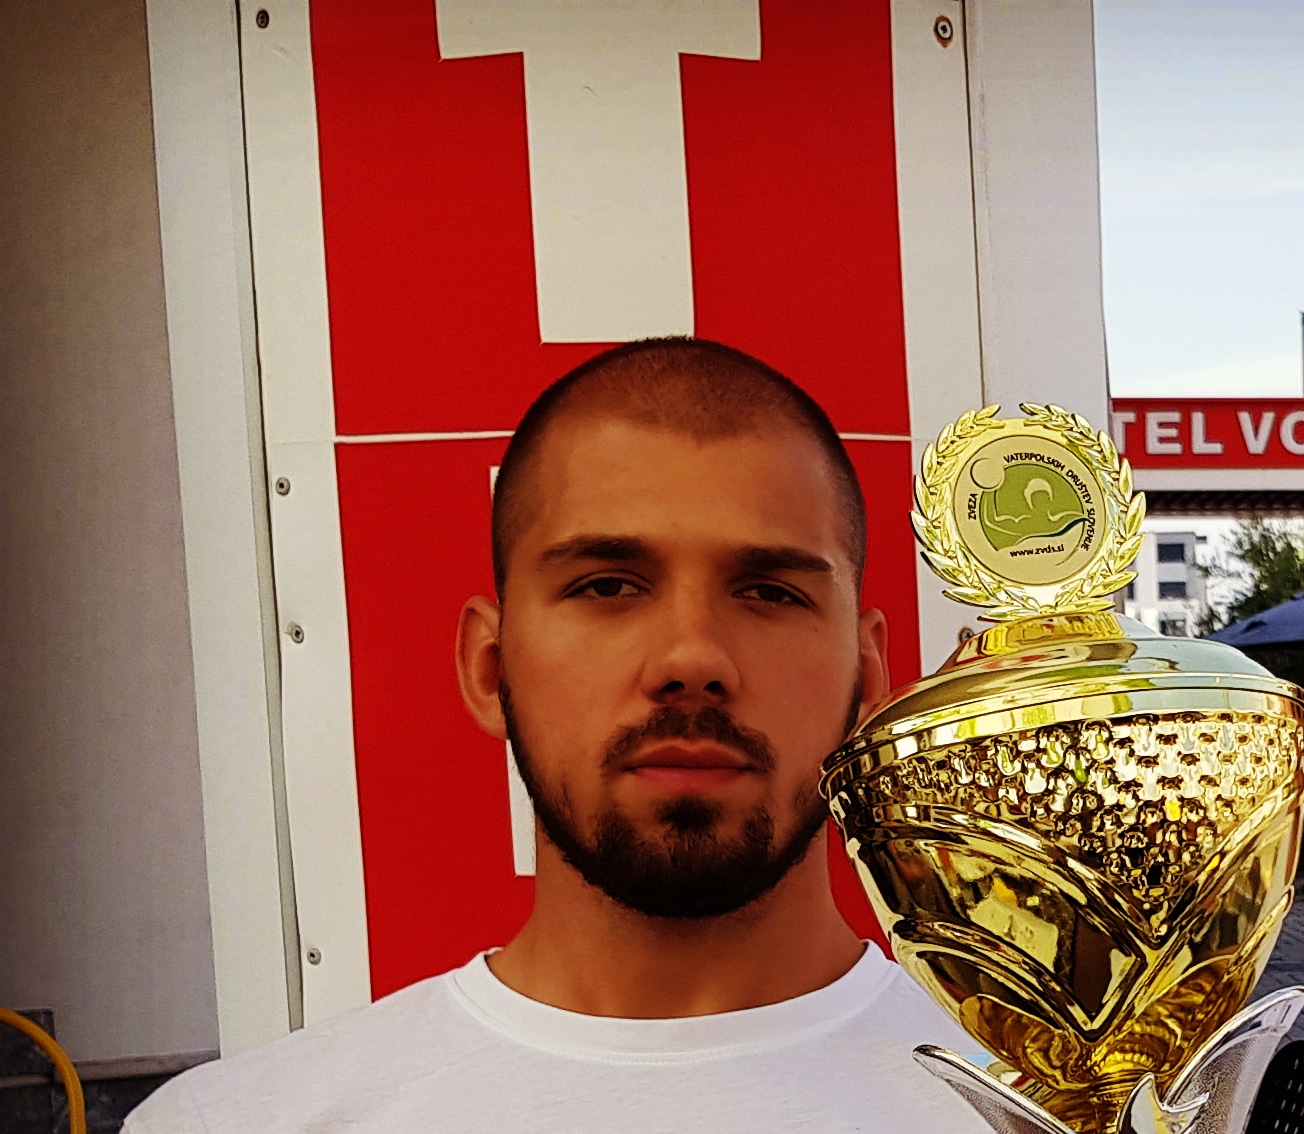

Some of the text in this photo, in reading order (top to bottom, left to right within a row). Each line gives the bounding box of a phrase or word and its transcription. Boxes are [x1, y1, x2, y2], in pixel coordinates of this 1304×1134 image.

[1110, 411, 1224, 455] TEL
[968, 493, 978, 520] ZVEZA
[1010, 544, 1065, 557] www.zvds.si
